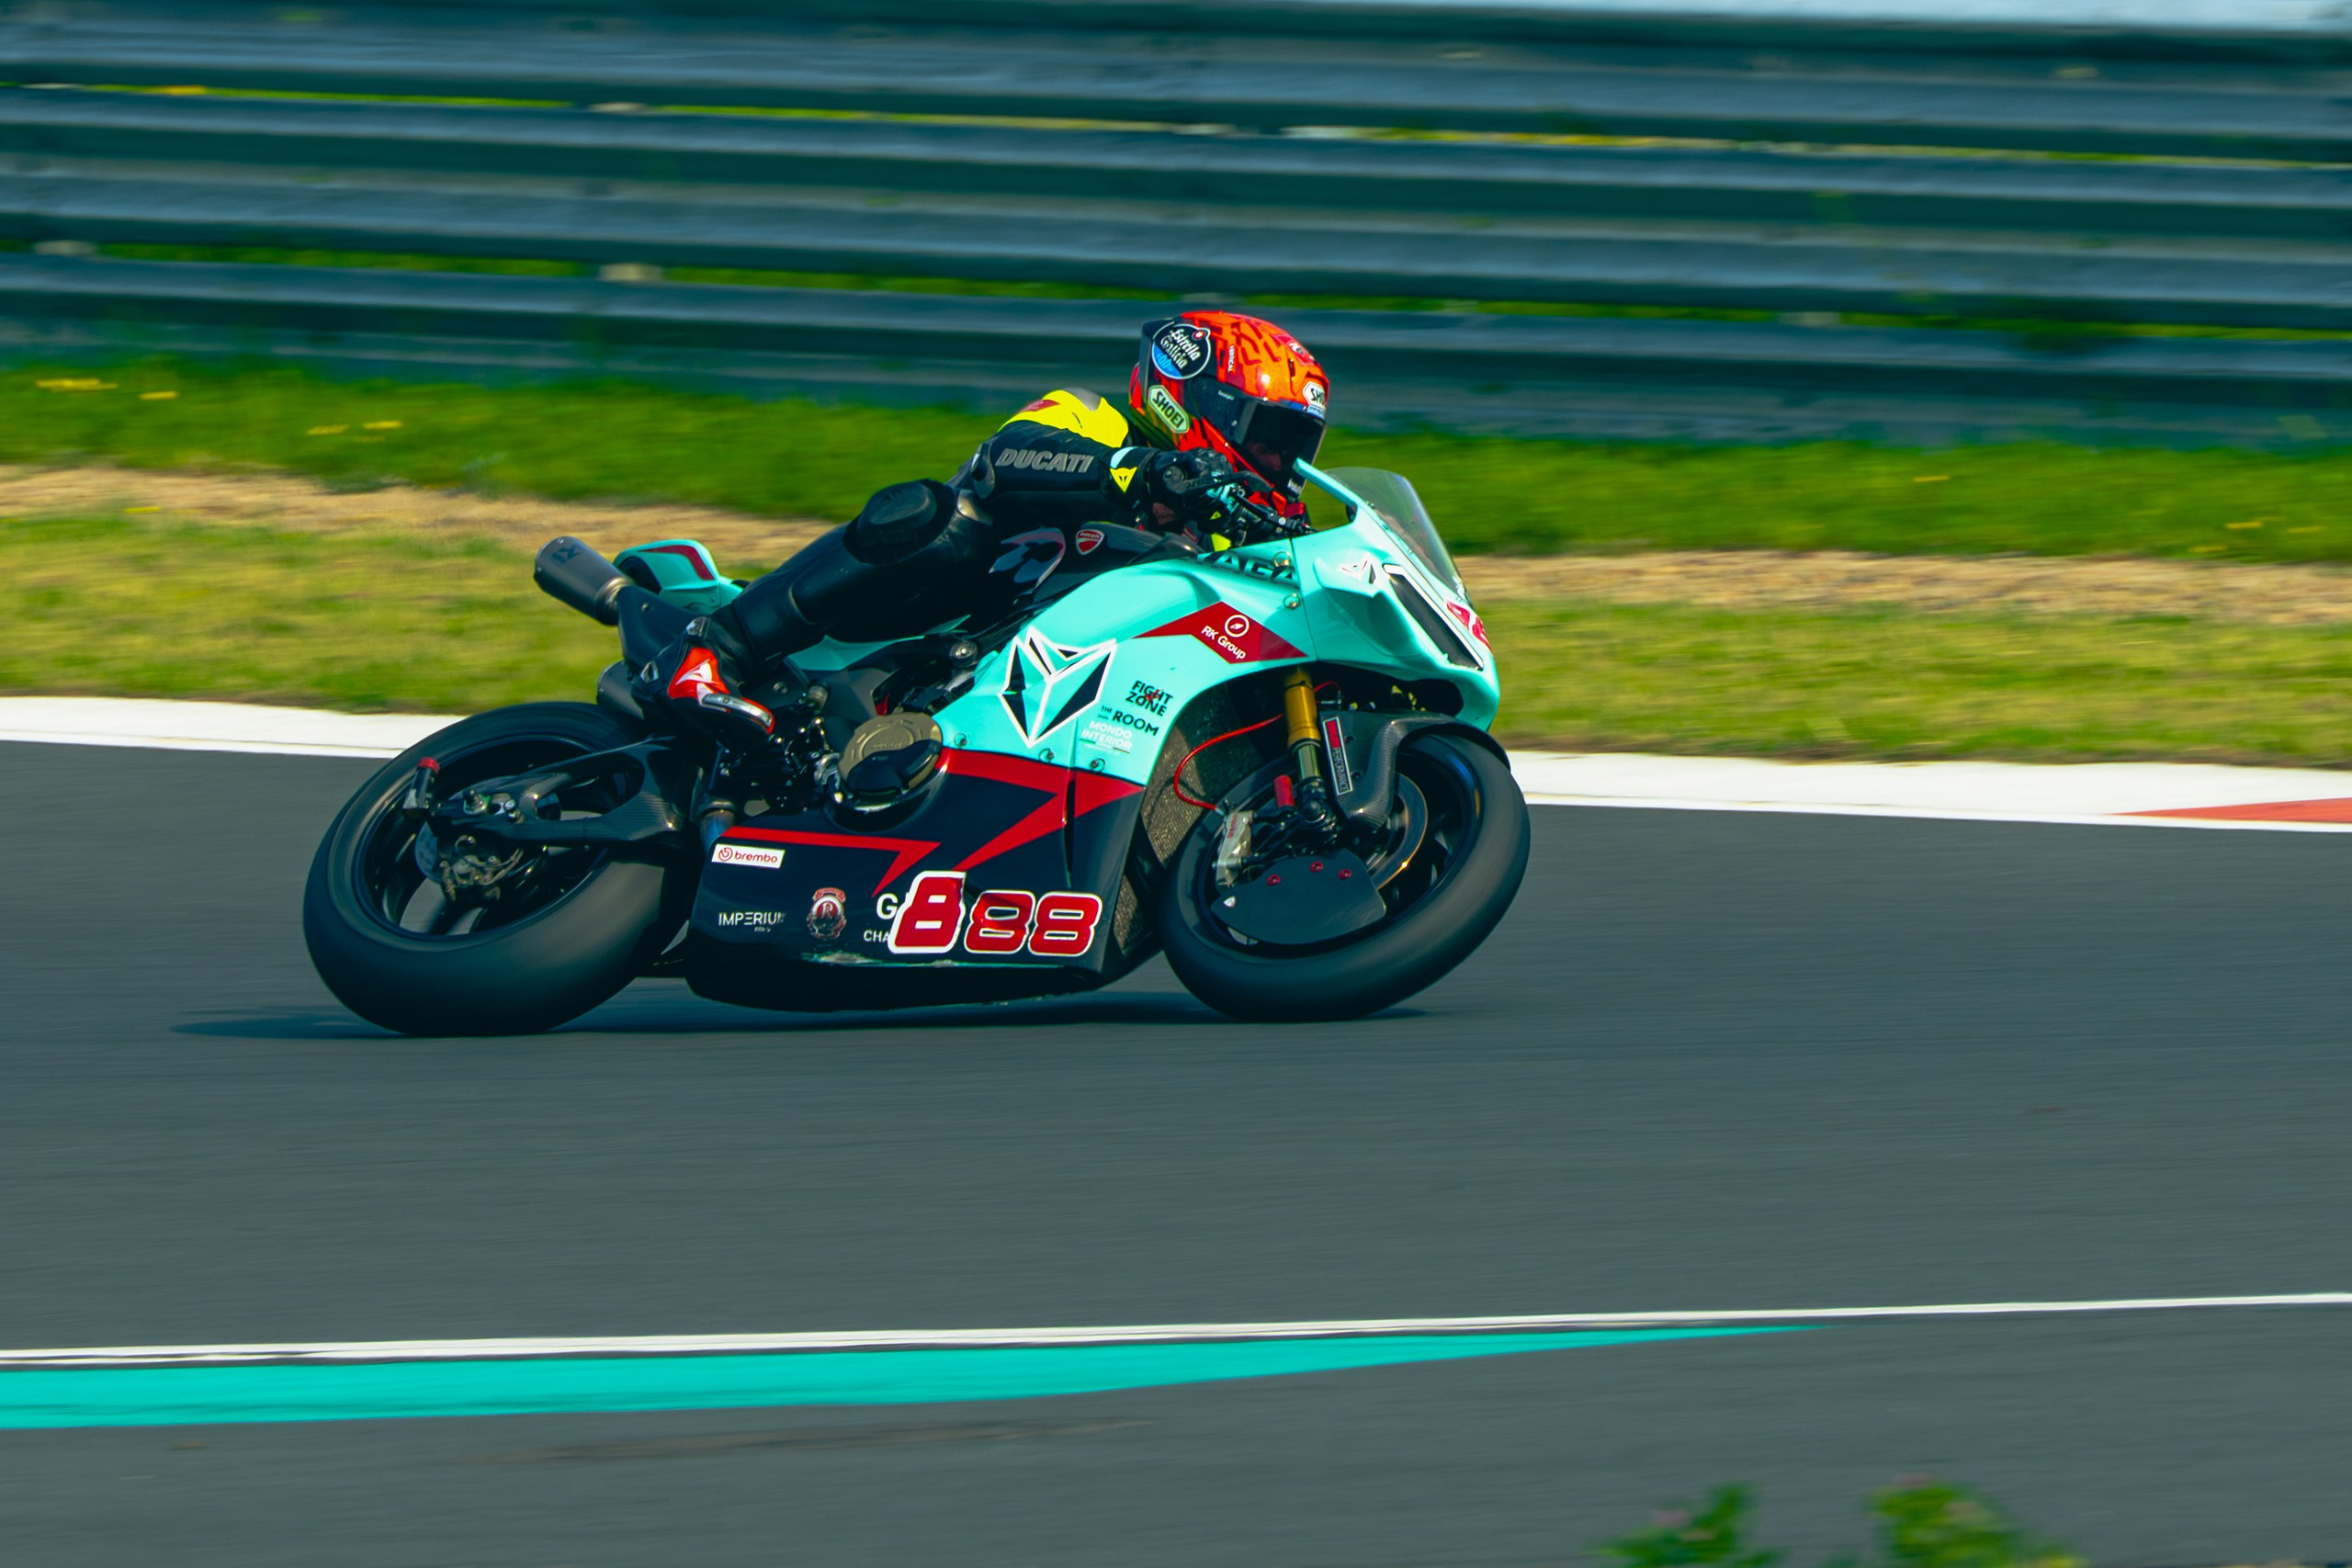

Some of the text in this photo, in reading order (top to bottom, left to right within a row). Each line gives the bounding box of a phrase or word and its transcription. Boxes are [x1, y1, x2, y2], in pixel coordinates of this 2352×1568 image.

[1170, 328, 1202, 362] Estrella
[1152, 390, 1185, 429] SHOEI
[995, 447, 1095, 474] DUCATI
[1201, 625, 1247, 660] RK Group
[1125, 691, 1168, 717] ZONE
[1131, 680, 1174, 705] FIGHT
[1089, 720, 1133, 740] MONDO
[1112, 710, 1160, 737] ROOM
[1080, 728, 1133, 750] INTERIOR
[734, 851, 778, 863] brembo
[888, 870, 1102, 956] 888
[863, 929, 891, 942] CHA
